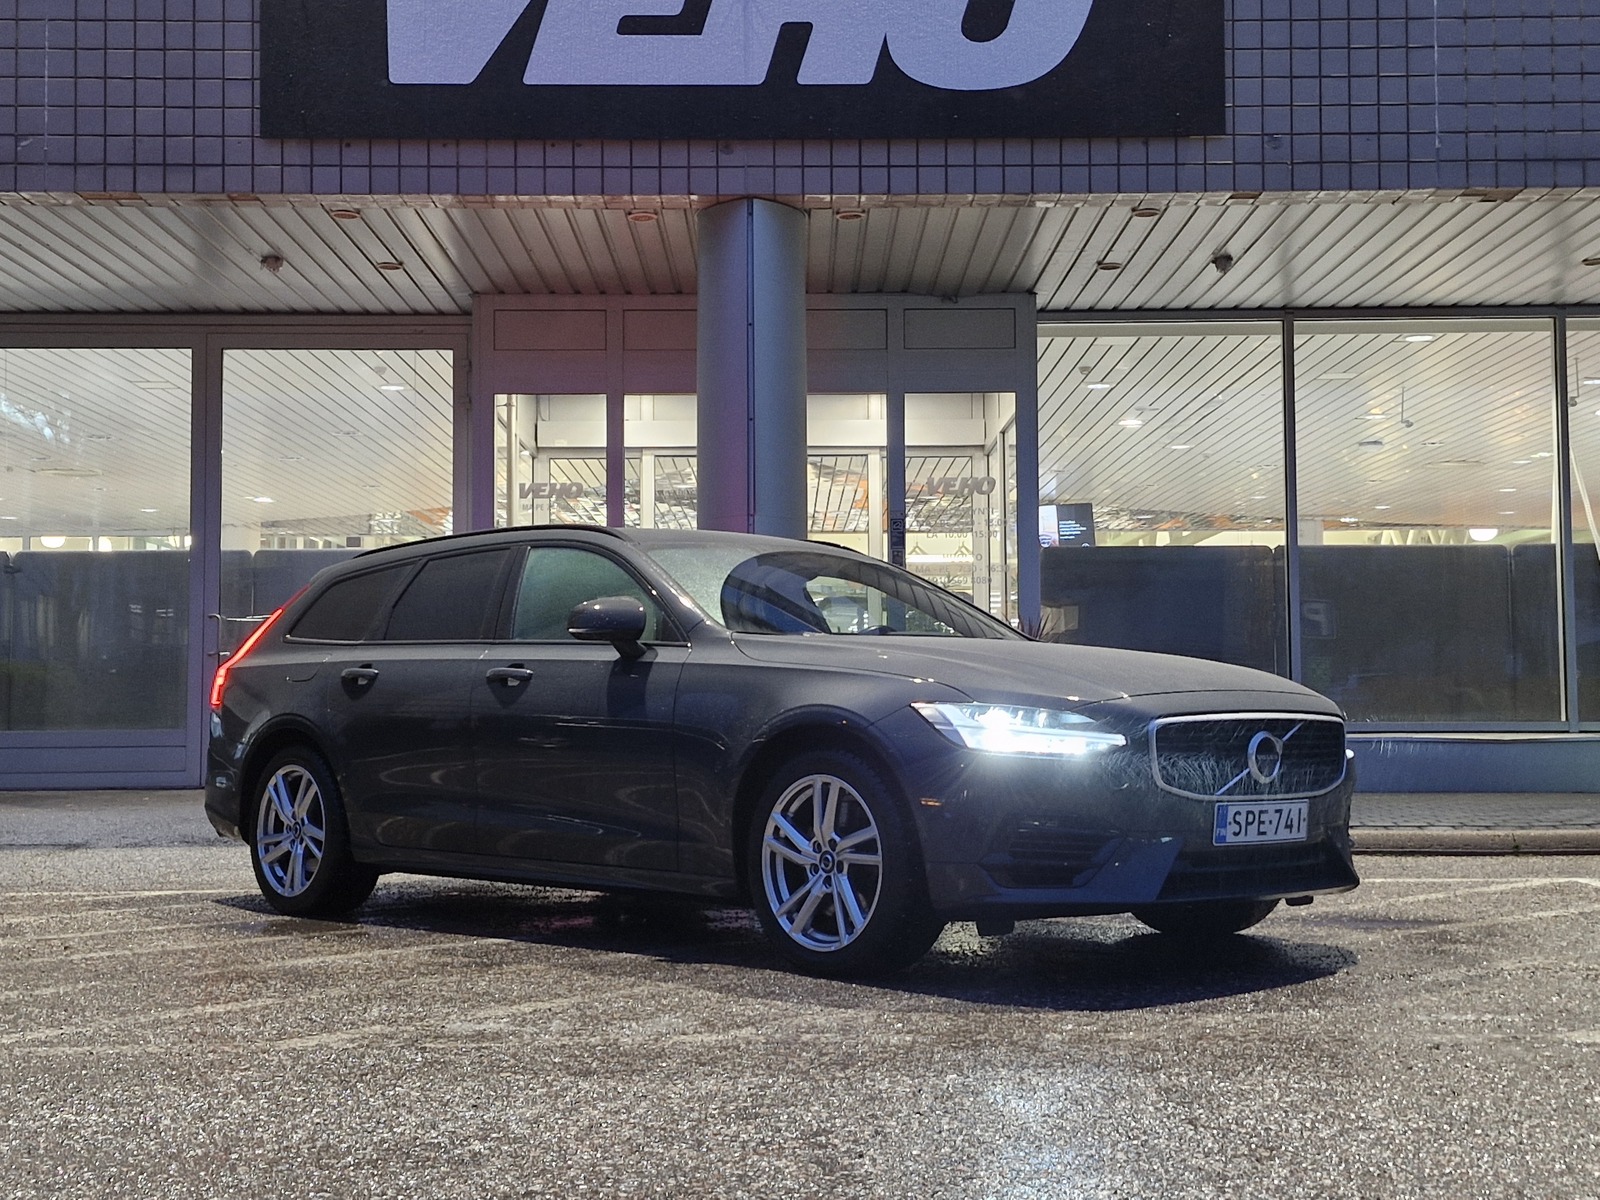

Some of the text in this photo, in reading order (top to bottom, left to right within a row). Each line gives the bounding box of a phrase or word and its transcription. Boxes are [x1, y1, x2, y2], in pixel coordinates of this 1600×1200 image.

[519, 482, 584, 499] VEHO
[927, 476, 996, 495] VEHO
[1232, 807, 1303, 837] SPE-741
